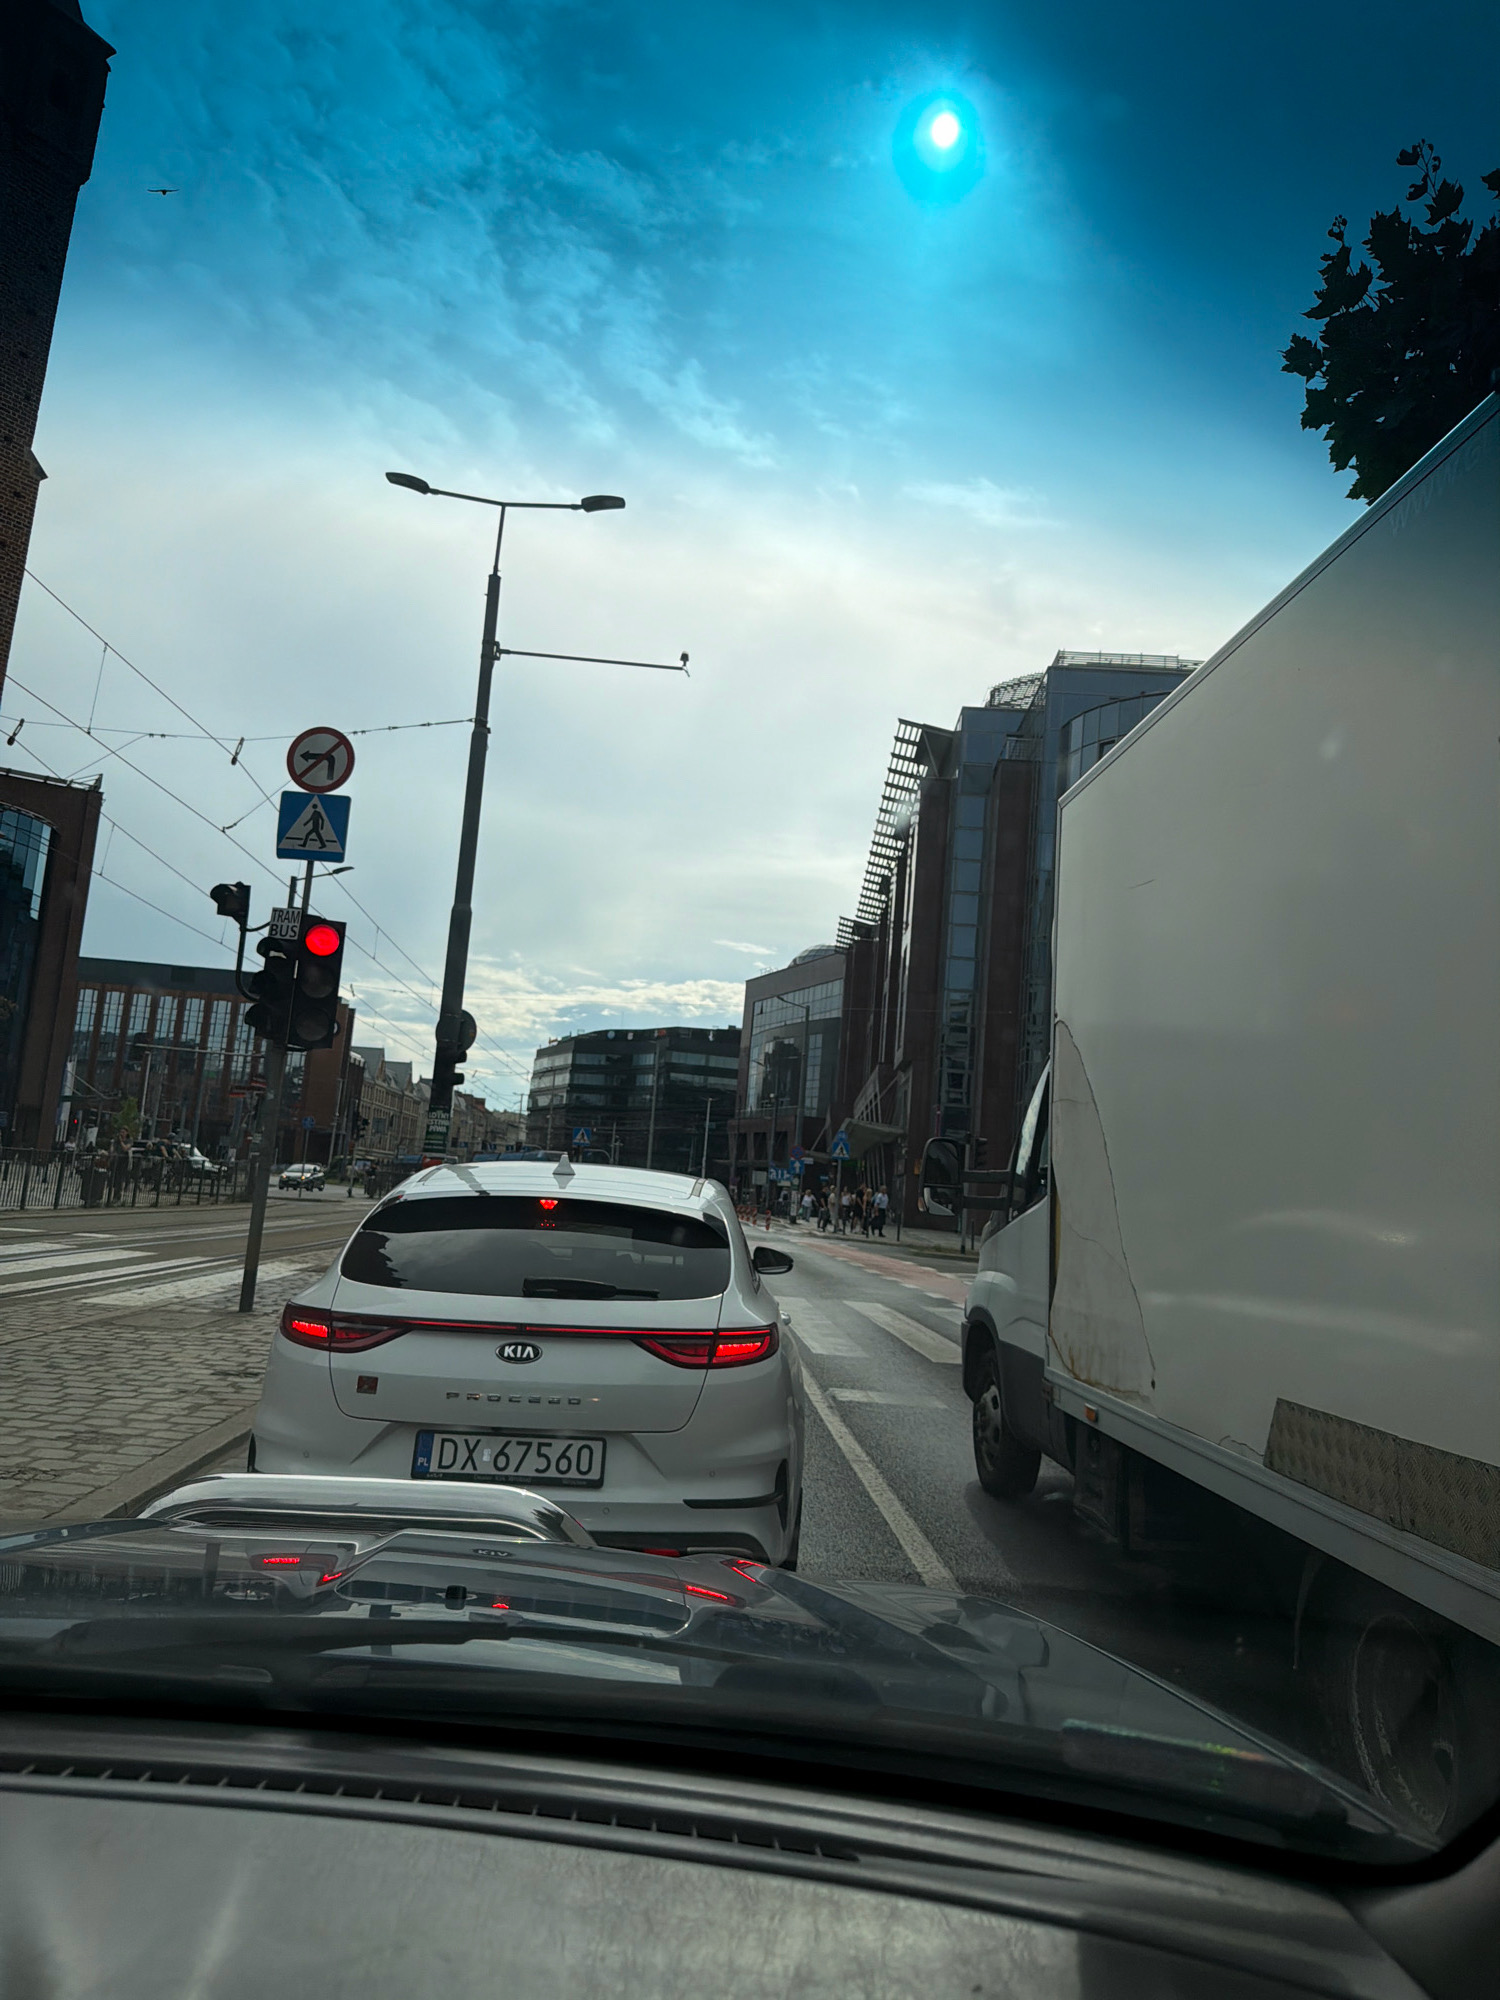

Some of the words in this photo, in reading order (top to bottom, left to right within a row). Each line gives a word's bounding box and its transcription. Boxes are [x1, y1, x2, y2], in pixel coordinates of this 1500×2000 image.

[272, 910, 300, 924] TRAM
[270, 924, 298, 938] BUS
[503, 1345, 535, 1359] KIA
[417, 1457, 429, 1467] PL
[437, 1437, 482, 1472] DX
[493, 1440, 594, 1476] 67560
